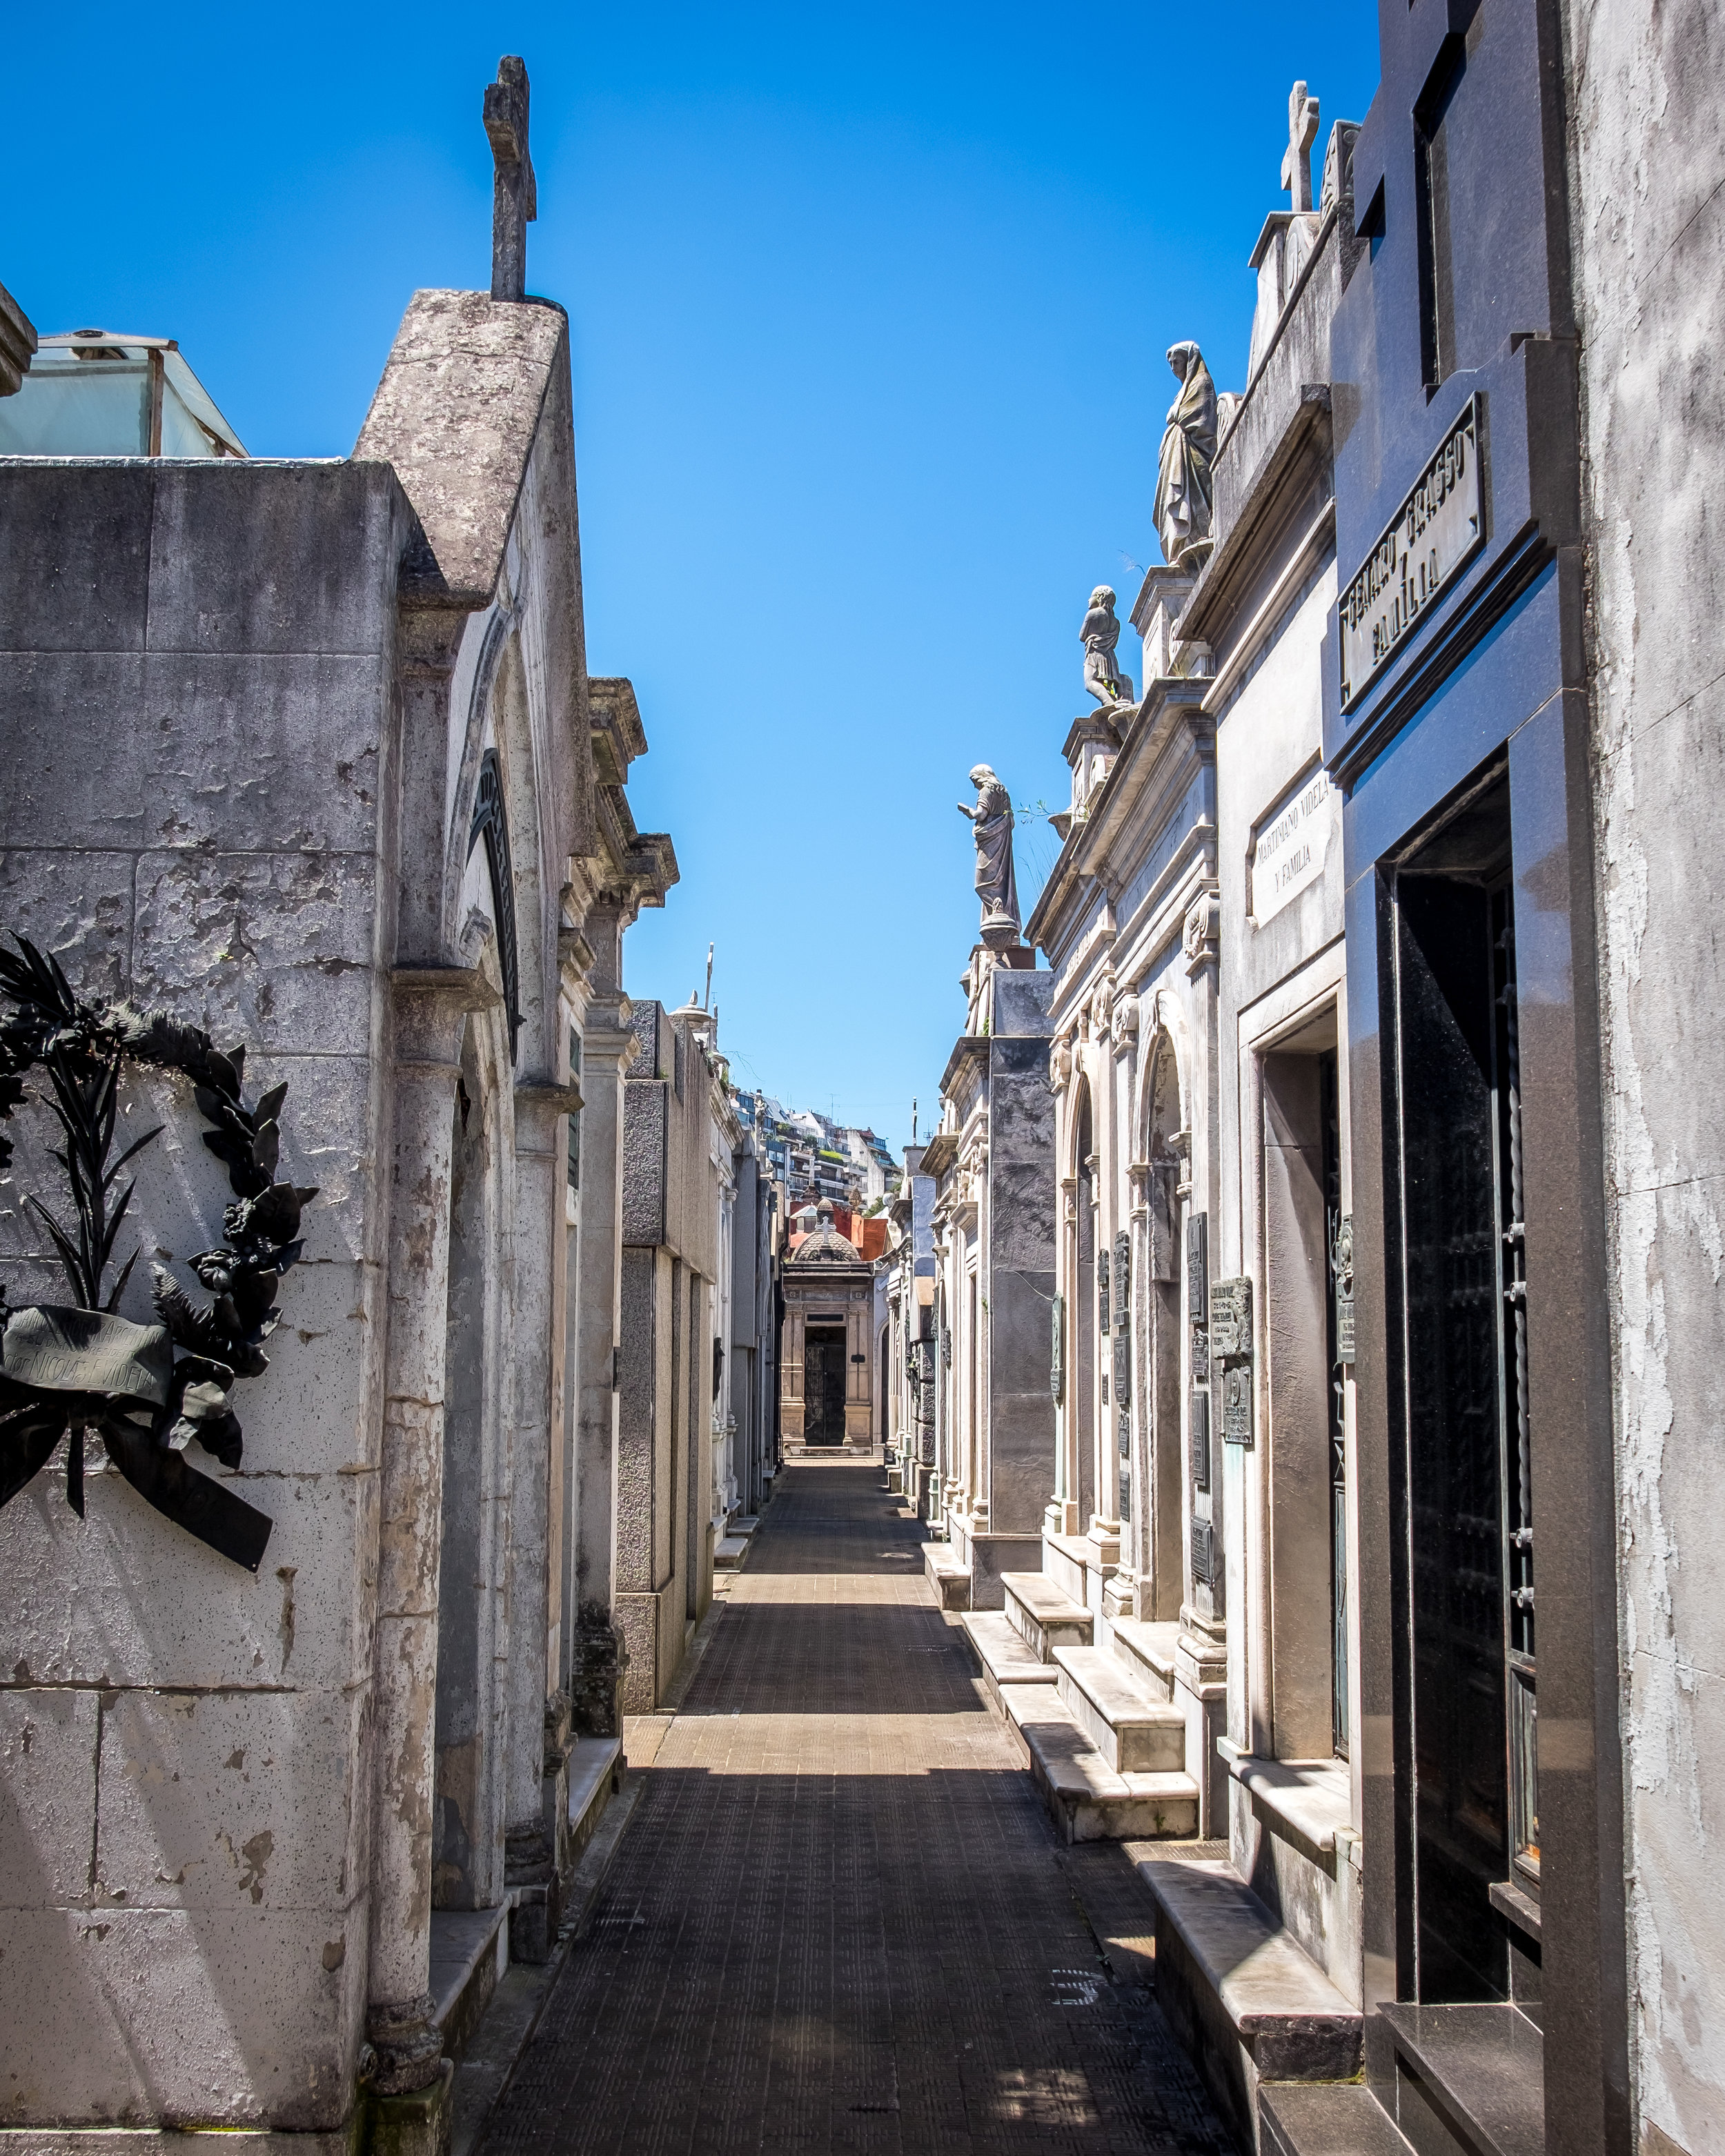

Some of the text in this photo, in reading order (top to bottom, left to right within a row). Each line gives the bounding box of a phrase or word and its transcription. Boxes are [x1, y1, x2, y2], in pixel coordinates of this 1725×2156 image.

[1349, 431, 1465, 631] GENARO GRASSO
[1399, 551, 1408, 587] Y
[1372, 548, 1439, 666] FAMILIA
[1258, 776, 1329, 867] MARTINIANO VIDELA
[1282, 842, 1311, 887] FAMILIA
[26, 1335, 43, 1346] SU
